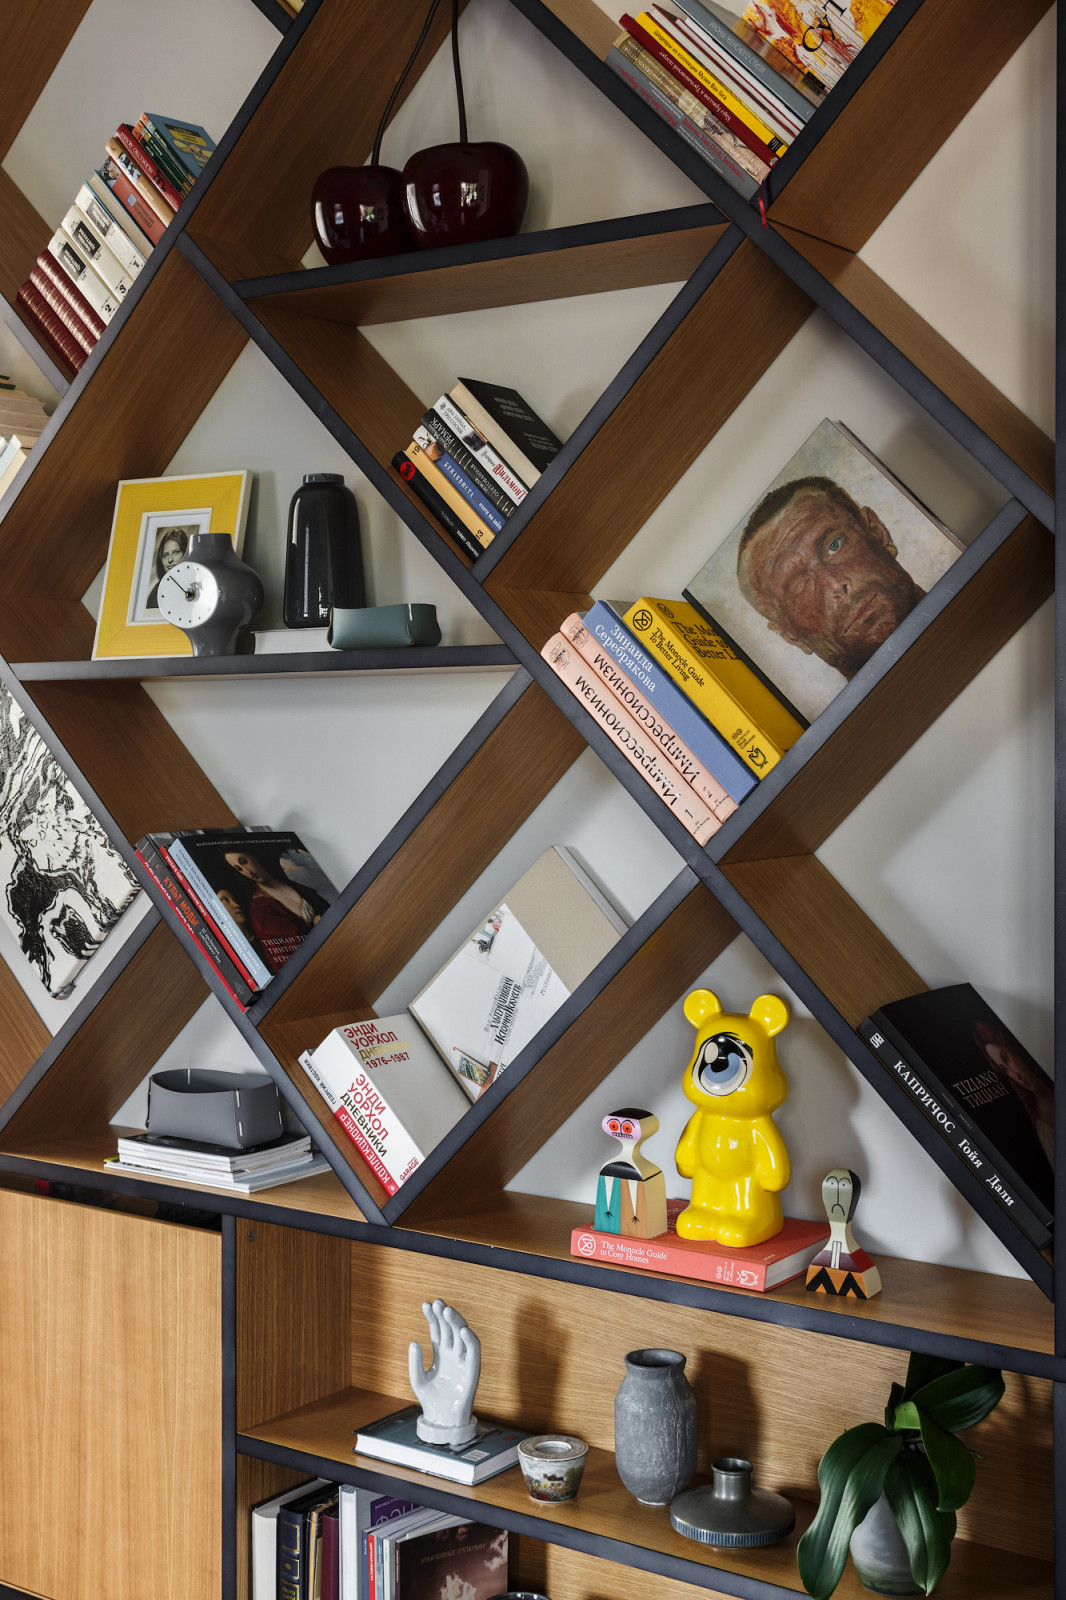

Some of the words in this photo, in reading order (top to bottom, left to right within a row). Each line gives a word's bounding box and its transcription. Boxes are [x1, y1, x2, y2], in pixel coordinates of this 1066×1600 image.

[708, 20, 727, 38] ИКОНЫ
[724, 34, 751, 60] ЖЕНСКОГО
[748, 56, 766, 73] СТИЛЯ
[652, 29, 673, 50] Шедевры
[676, 52, 698, 73] коллекции
[696, 70, 711, 85] Музея
[709, 83, 719, 92] Ван
[717, 90, 727, 100] Гога
[671, 63, 702, 93] Третьяковской
[702, 92, 722, 112] Брюллов
[681, 117, 702, 138] Rubens,
[699, 134, 711, 146] Van
[708, 143, 724, 160] Dyck,
[429, 416, 454, 444] РЕМАРК
[442, 460, 476, 498] БЕНАКВИСТА
[469, 463, 500, 497] ОБЕТОВАННАЯ
[474, 529, 484, 540] 13
[672, 621, 690, 637] The
[685, 635, 714, 650] Guide
[718, 640, 730, 649] to
[595, 624, 656, 692] Серебрякова
[610, 624, 654, 672] Зинаида
[649, 635, 656, 645] To
[655, 641, 673, 665] Better
[671, 661, 690, 682] Living
[655, 627, 666, 642] The
[664, 640, 689, 668] Monocle
[687, 666, 705, 687] Guide
[696, 647, 730, 660] Better
[594, 654, 700, 784] Импрессионизм
[576, 676, 681, 806] Импрессионизм
[703, 786, 712, 798] 2
[684, 808, 694, 818] 1
[161, 874, 183, 902] КУЛЬТ
[178, 899, 201, 927] МОДЫ
[344, 1023, 378, 1038] ЭНДИ
[350, 1032, 398, 1049] УОРХОЛ
[358, 1042, 410, 1062] ДНЕВНИКИ
[304, 1059, 320, 1082] КОСТАКИ
[952, 1070, 999, 1096] TIZIANO
[320, 1081, 337, 1105] ГЕОРГИЙ
[356, 1074, 387, 1115] ЭНДИ
[963, 1084, 1010, 1108] ТИЦИАН
[340, 1092, 388, 1157] ДНЕВНИКИ
[348, 1082, 389, 1141] УОРХОЛ
[893, 1060, 955, 1133] КАПРИЧОС
[958, 1139, 984, 1168] Гойя
[986, 1174, 1015, 1206] Дали
[340, 1114, 390, 1184] КОЛЛЕКЦИОНЕР
[400, 1158, 420, 1181] GARAGE
[601, 1241, 614, 1250] The
[616, 1244, 645, 1256] Monocle
[647, 1250, 668, 1260] Guide
[608, 1250, 624, 1260] Cosy
[626, 1254, 649, 1264] Homes
[420, 1549, 455, 1564] УТРАЧЕННЫЕ
[456, 1543, 486, 1556] ИЛЛЮЗИИ
